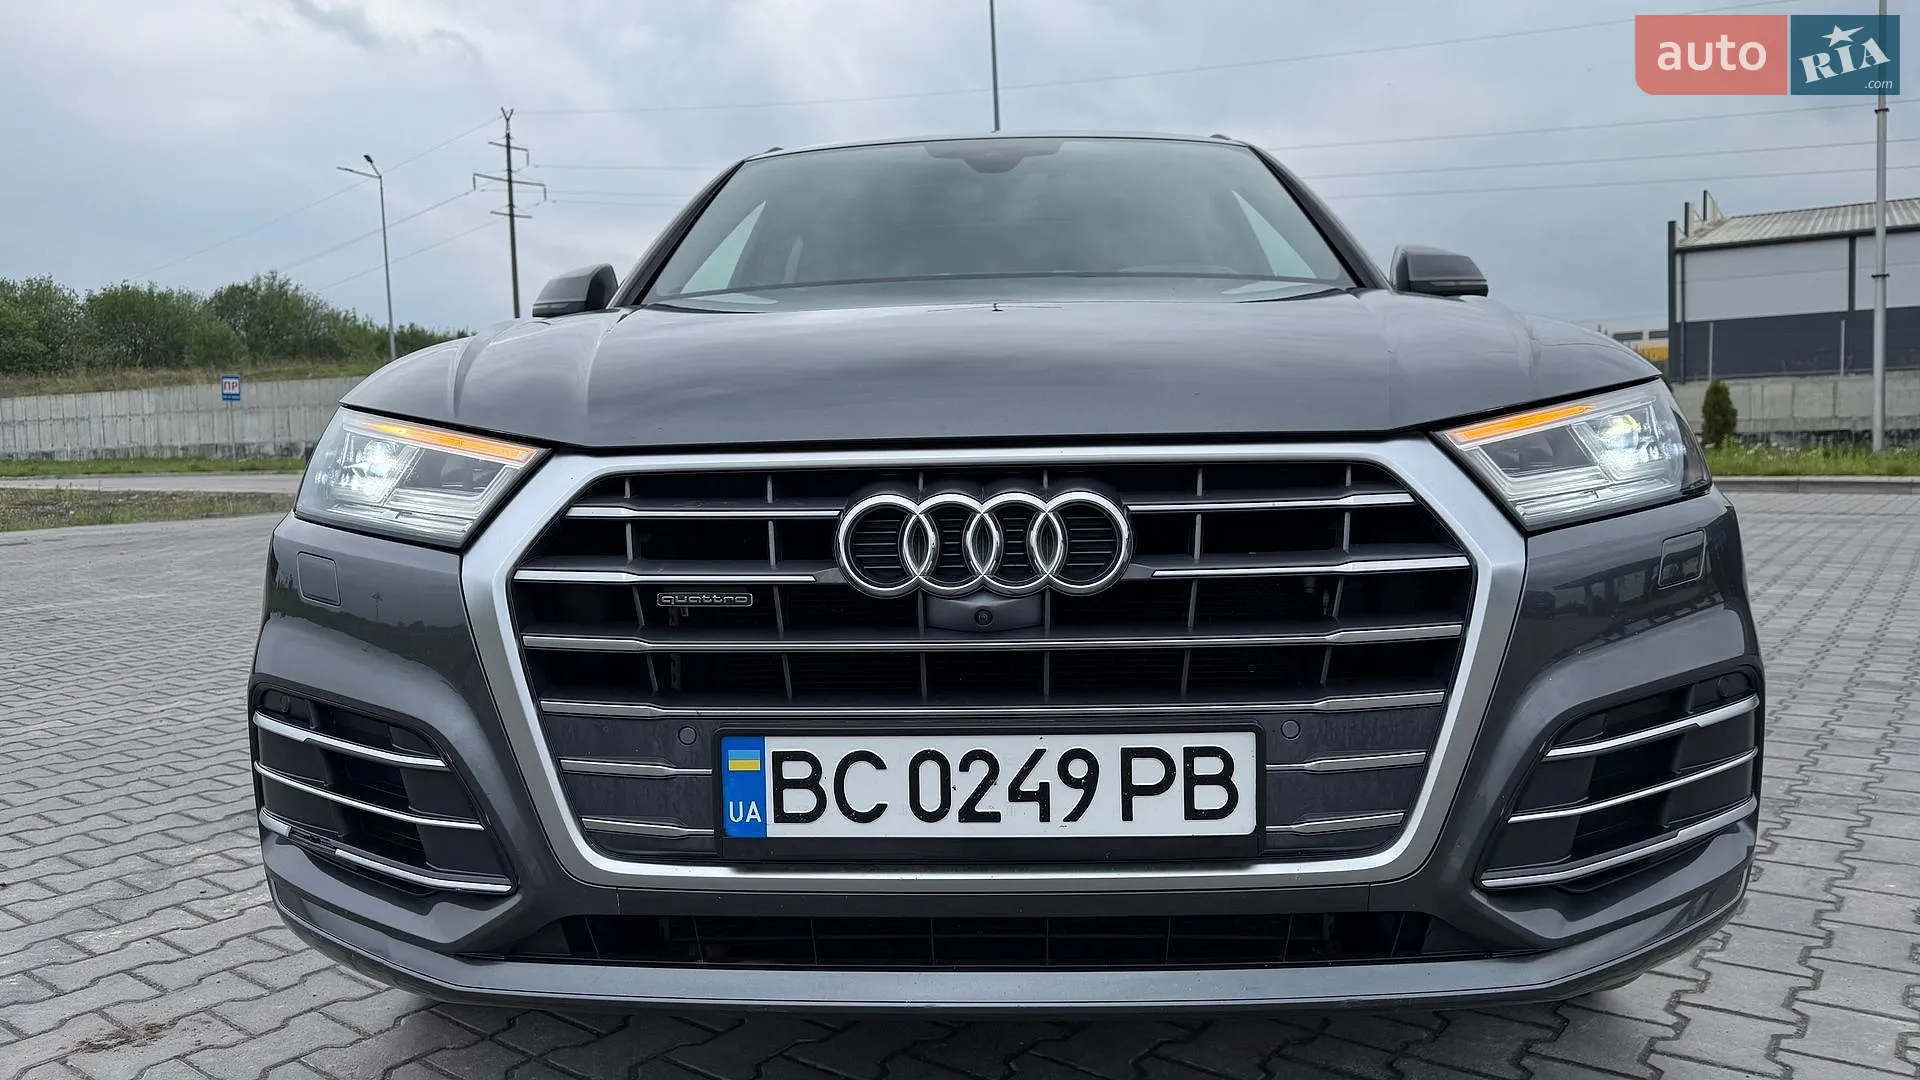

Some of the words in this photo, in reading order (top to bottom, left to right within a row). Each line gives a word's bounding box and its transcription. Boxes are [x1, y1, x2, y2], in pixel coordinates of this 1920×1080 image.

[661, 595, 748, 605] quattro
[772, 749, 888, 823] BC
[909, 749, 1100, 823] 0249
[1120, 745, 1240, 821] PB
[729, 801, 762, 823] UA
